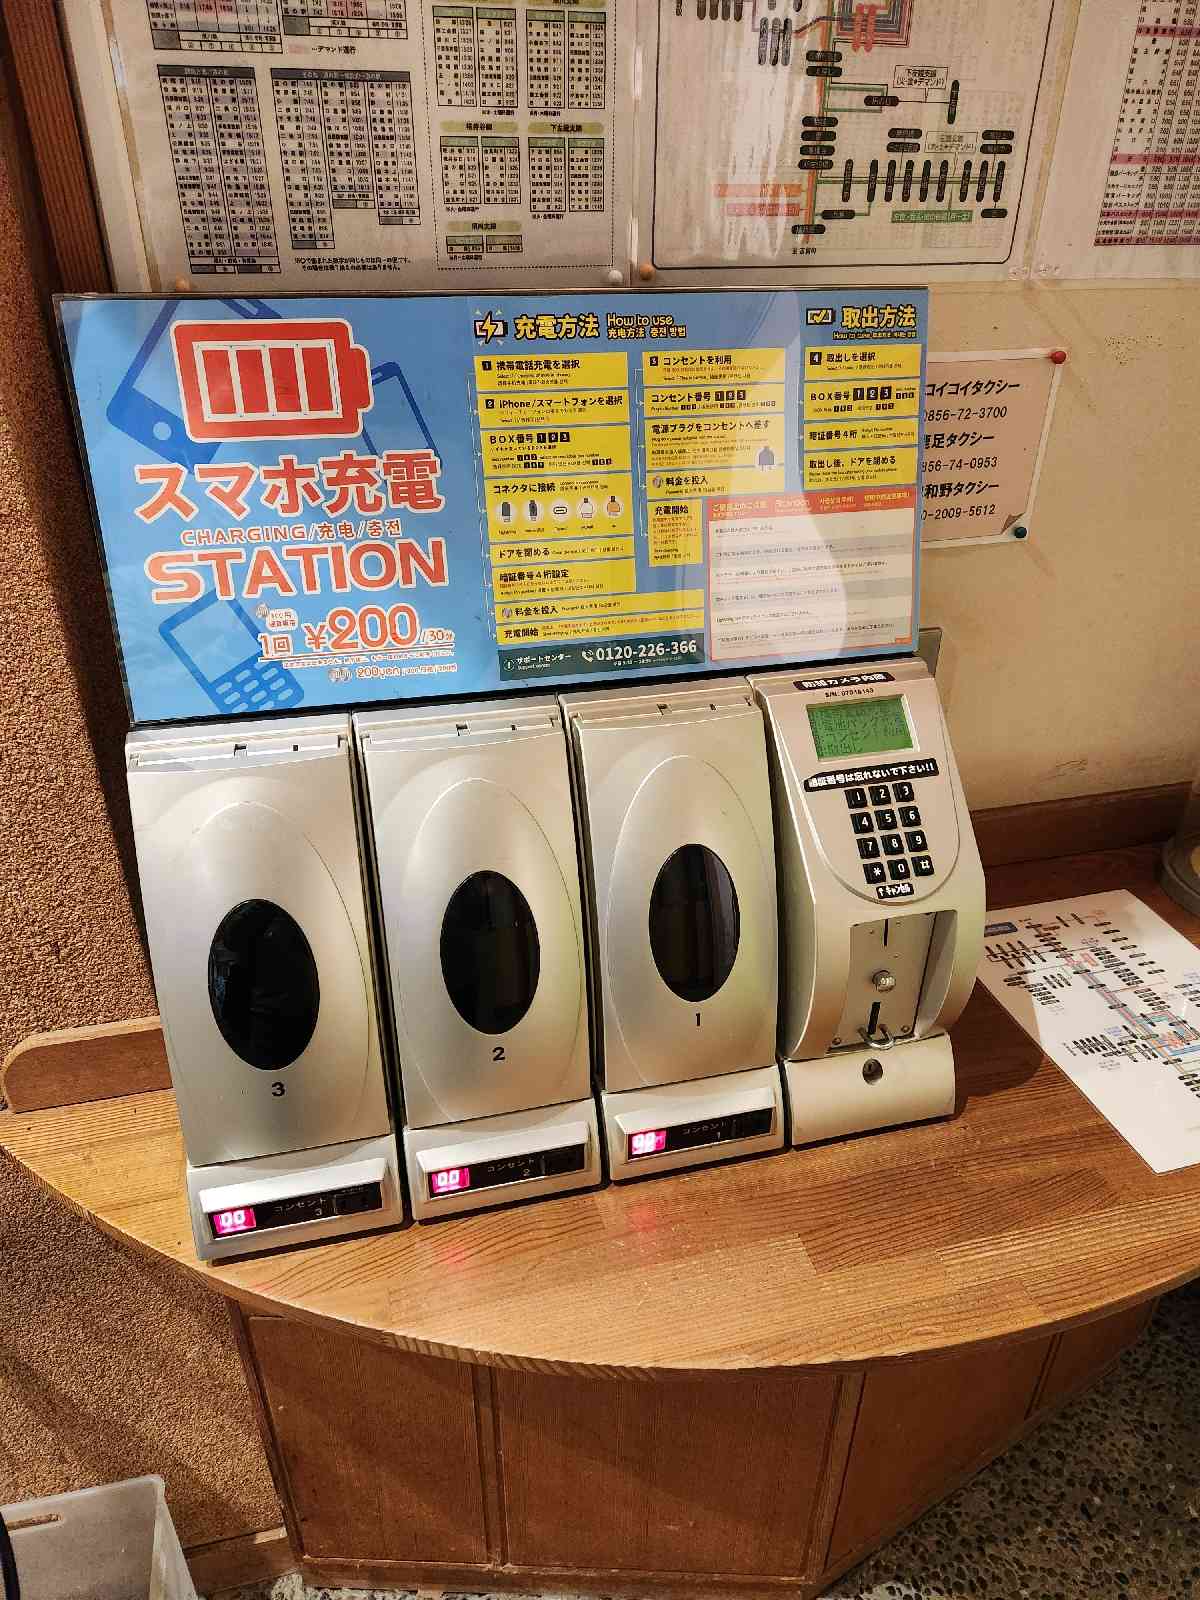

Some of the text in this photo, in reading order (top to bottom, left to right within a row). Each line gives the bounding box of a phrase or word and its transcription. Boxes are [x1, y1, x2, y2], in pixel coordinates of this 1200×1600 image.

[607, 314, 674, 327] How to use
[841, 304, 918, 329] 取出方法
[514, 314, 600, 340] 充電方法
[663, 354, 732, 366] コンセントを利用
[826, 352, 876, 363] 取出しを選択
[496, 359, 580, 371] 携帯電話充電を選択
[499, 395, 623, 409] iPhone/スマートフォンを選択
[652, 391, 711, 403] コンセント番号
[811, 391, 850, 401] BOX番号
[652, 420, 770, 434] 電源プラグをコンセントへ差す
[490, 433, 533, 444] BOX番号
[134, 448, 446, 523] スマホ充電
[665, 475, 709, 486] 料金を投入
[493, 482, 556, 494] コネクタに接続
[922, 480, 1000, 499] 和野タクシー
[656, 504, 689, 515] 充電開始
[499, 547, 550, 559] ドアを閉める
[144, 536, 449, 604] STATION
[499, 569, 569, 583] 暗証番号4桁設定
[514, 604, 559, 617] 料金を投入
[259, 633, 293, 658] 1回
[303, 602, 420, 651] ¥200
[503, 628, 539, 639] 充電開始
[595, 640, 697, 662] 0120-226-366
[515, 653, 572, 665] サポートセンター
[856, 785, 910, 801] 1 2 3
[861, 810, 916, 827] 4 5 6
[865, 835, 922, 851] 7 8 9
[897, 863, 905, 873] 0
[694, 1011, 700, 1028] 1
[491, 1047, 506, 1062] 2
[271, 1082, 286, 1097] 3
[522, 1168, 531, 1177] 2
[314, 1207, 323, 1217] 3
